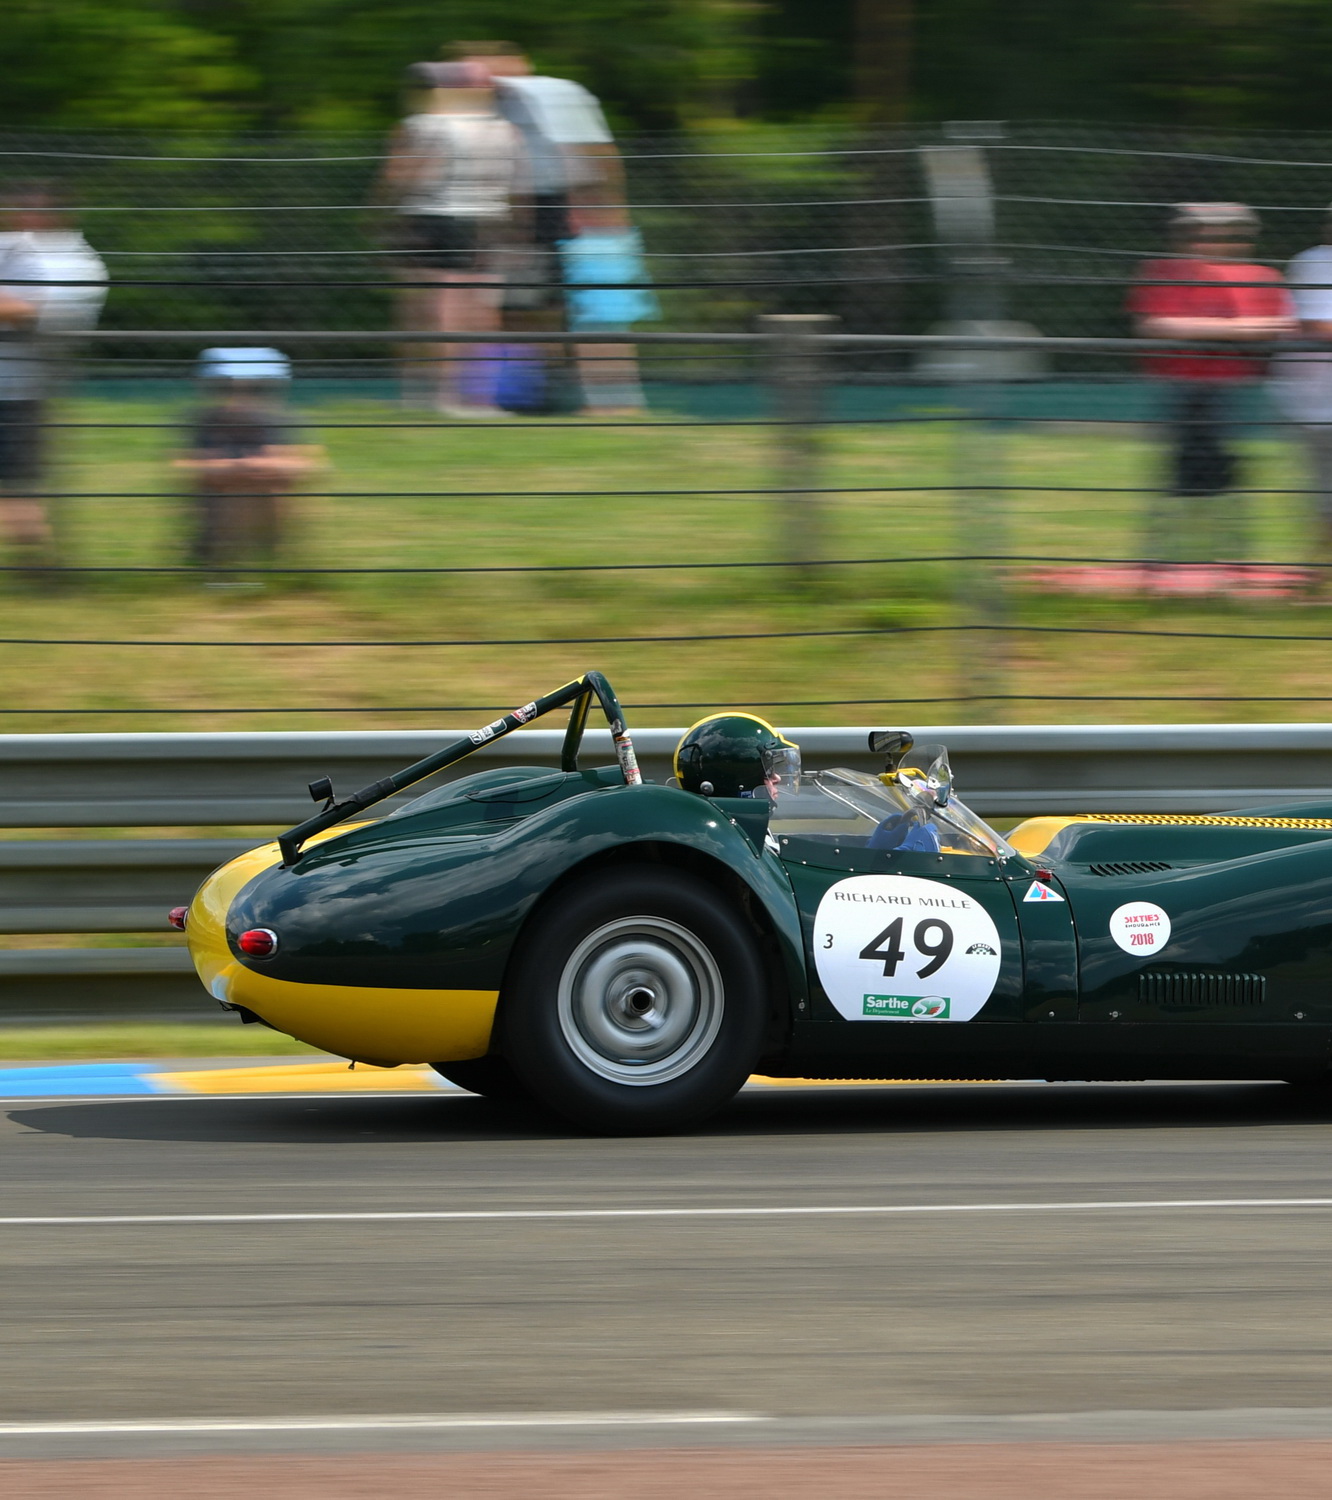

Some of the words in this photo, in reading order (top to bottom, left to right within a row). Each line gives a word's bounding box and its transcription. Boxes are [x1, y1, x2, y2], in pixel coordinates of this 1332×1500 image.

[834, 891, 912, 905] RICHARD
[918, 897, 971, 909] MILLE
[1124, 914, 1160, 923] SIXTIES
[823, 933, 834, 949] 3
[1130, 932, 1154, 945] 2018
[858, 917, 954, 980] 49
[866, 996, 909, 1009] Sarthe
